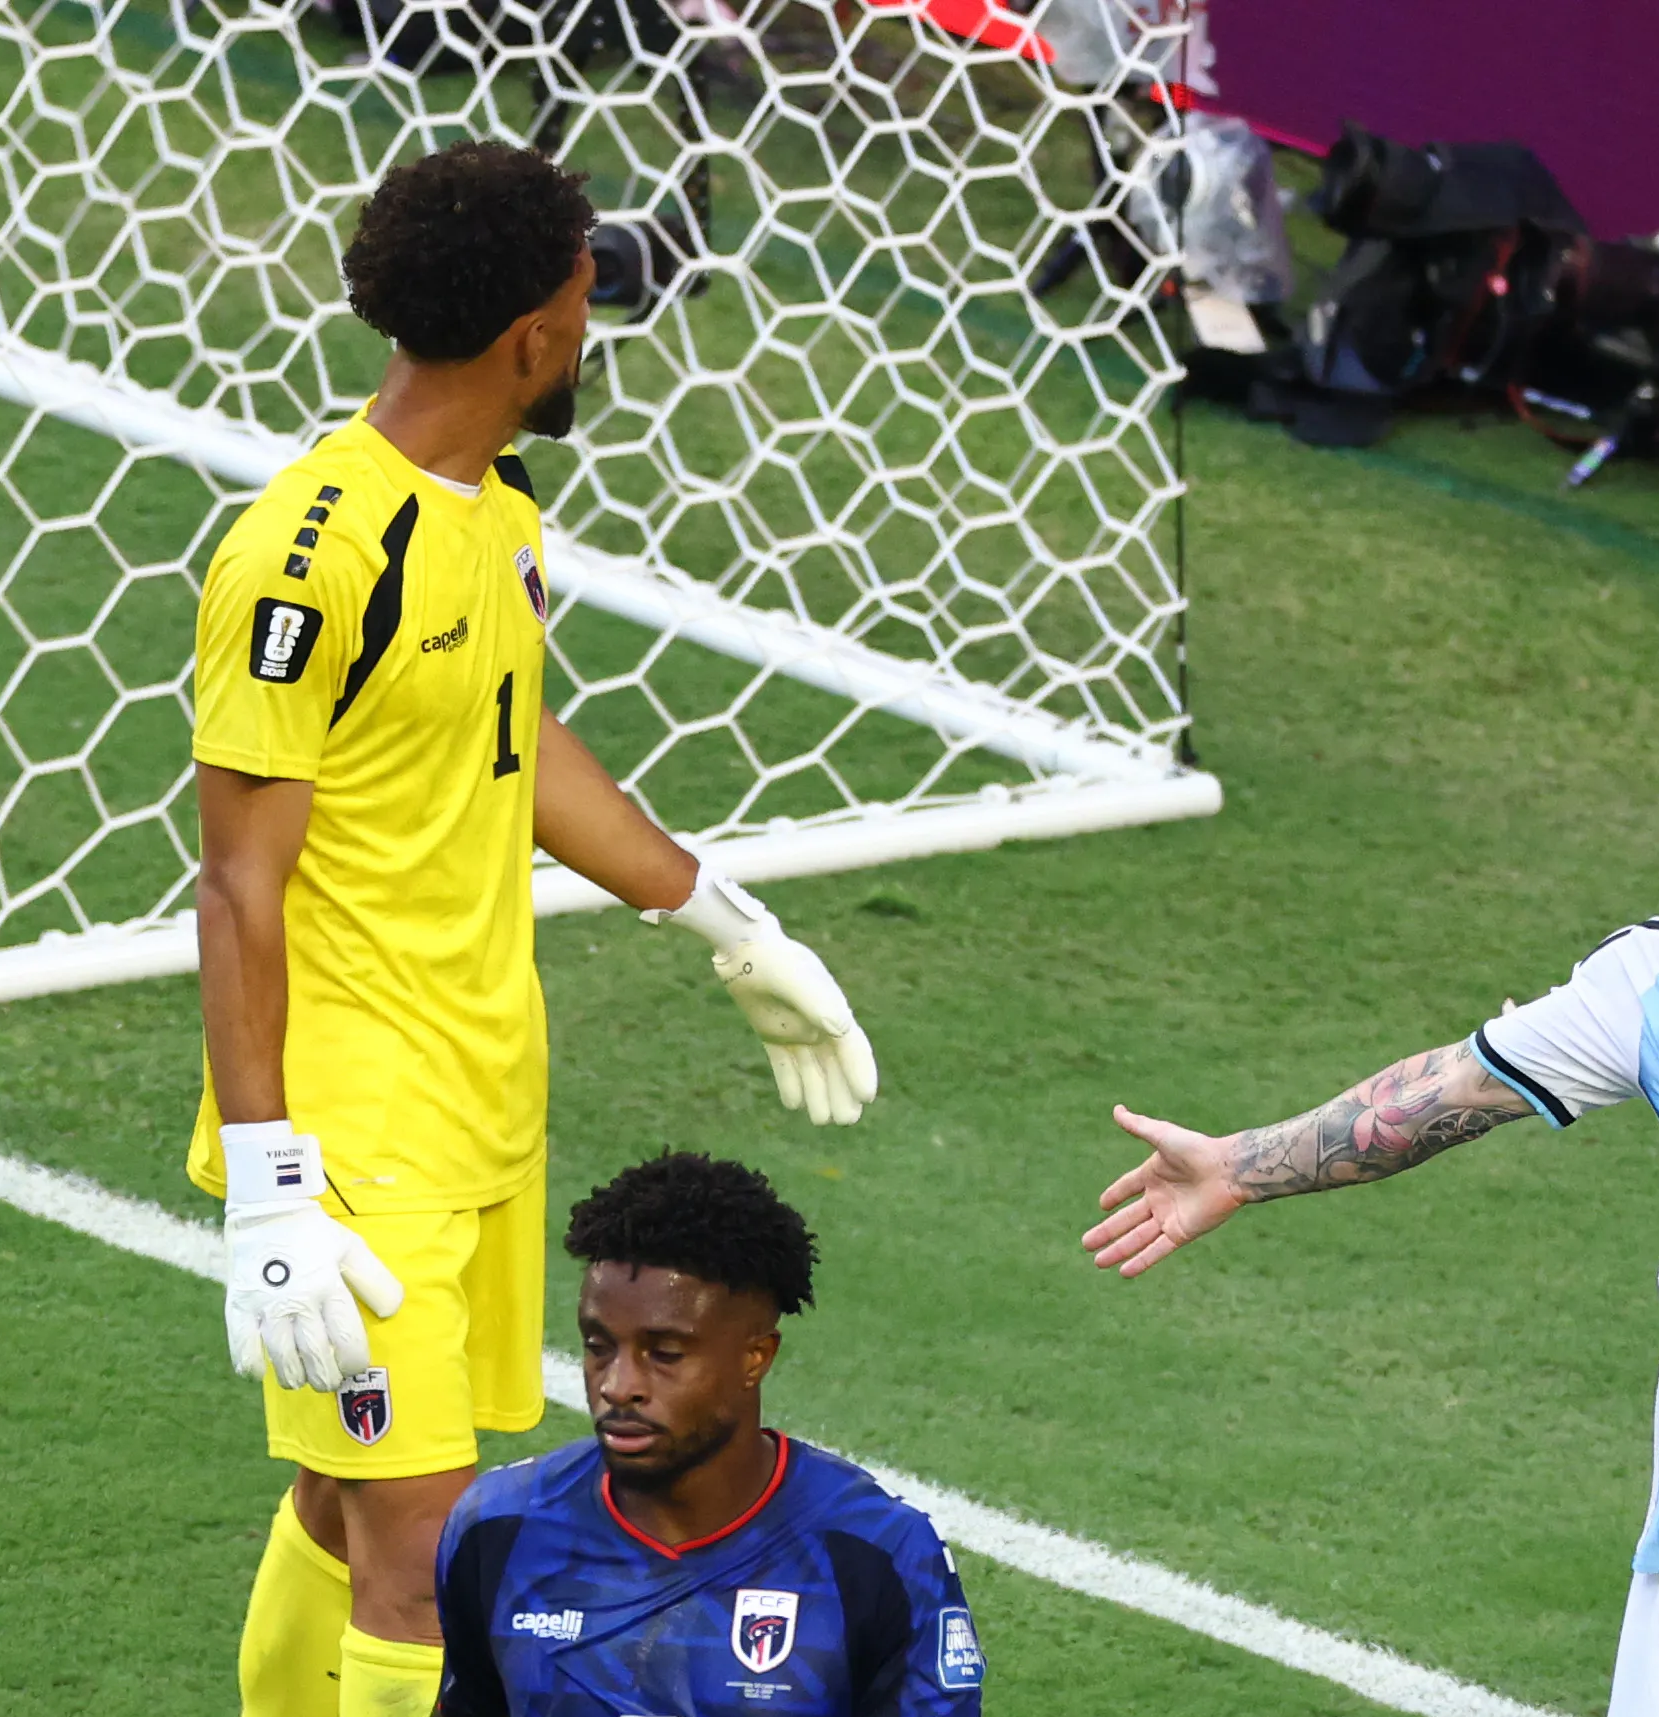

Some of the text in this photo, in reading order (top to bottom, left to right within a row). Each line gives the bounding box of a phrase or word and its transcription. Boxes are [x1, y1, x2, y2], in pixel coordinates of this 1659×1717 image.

[421, 616, 469, 654] capelli
[491, 670, 521, 781] 1
[742, 1594, 794, 1608] FCF
[511, 1609, 584, 1636] capelli
